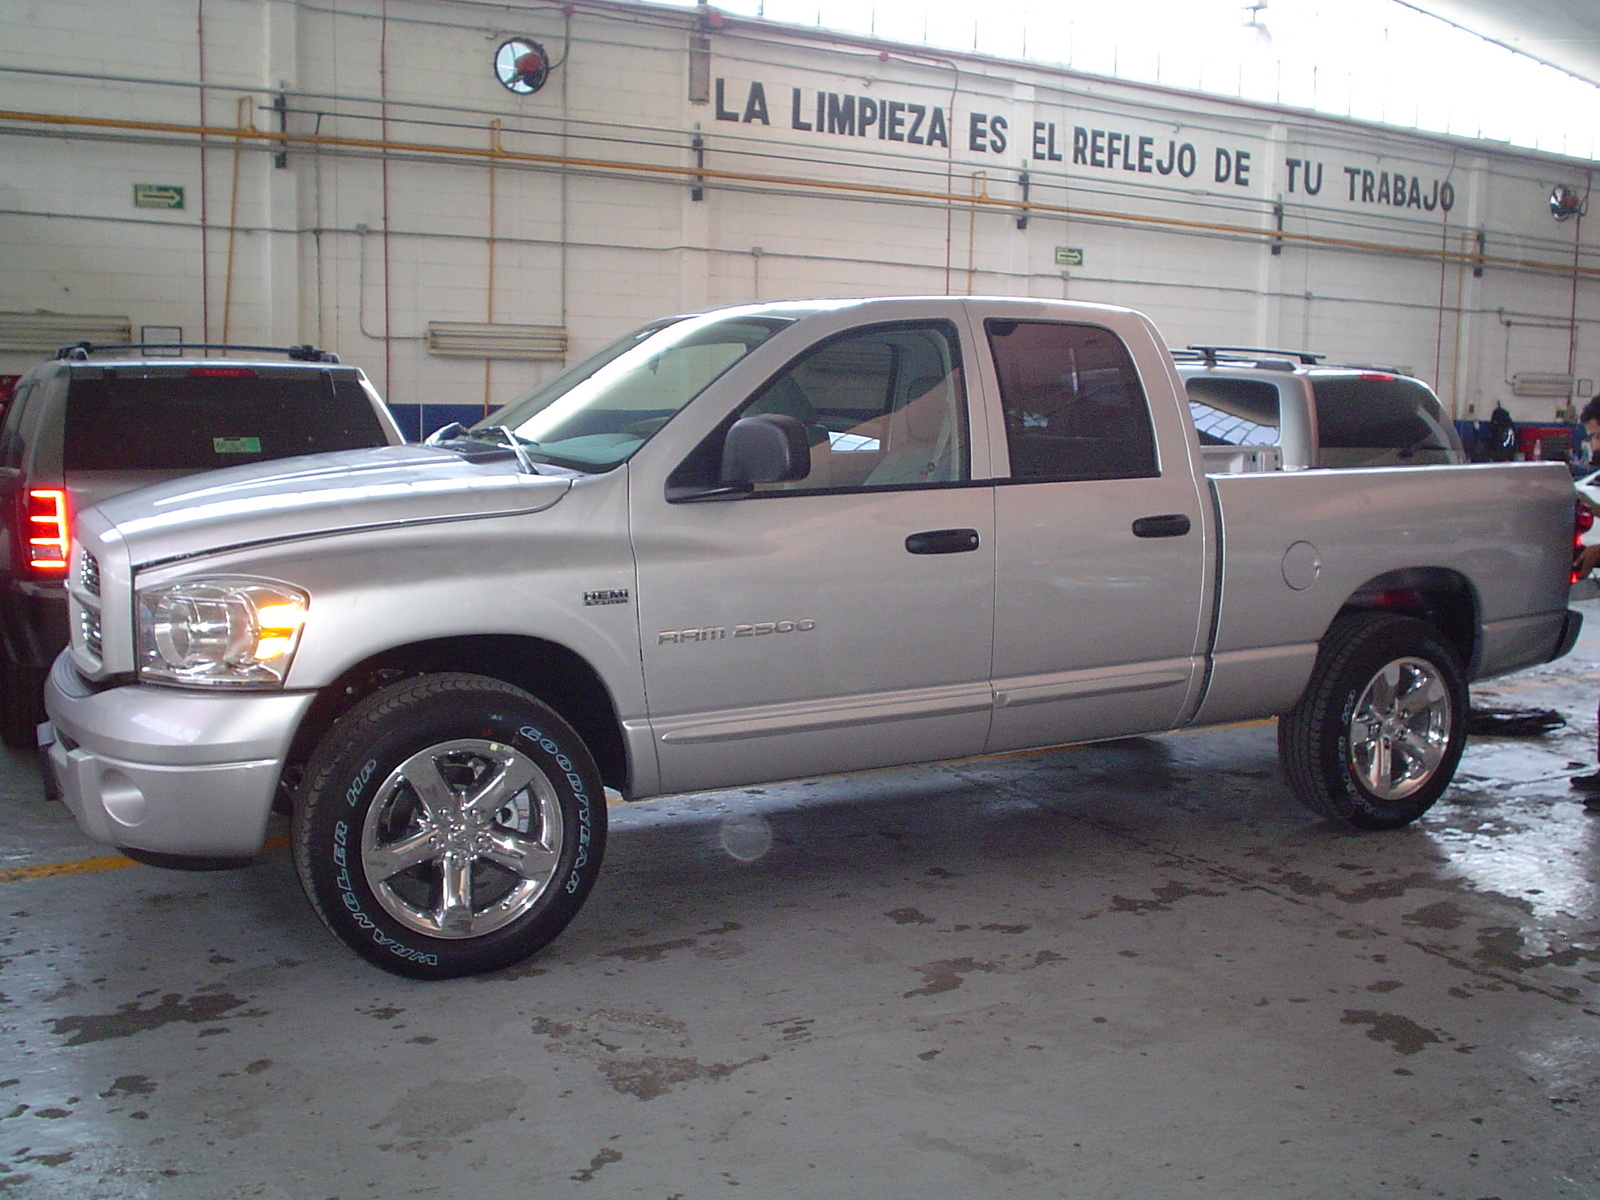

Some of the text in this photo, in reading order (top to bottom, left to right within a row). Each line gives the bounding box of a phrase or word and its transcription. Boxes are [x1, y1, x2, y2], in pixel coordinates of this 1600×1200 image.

[715, 77, 1455, 212] LA LIMPIEZA ES EL REFLEJO DE TU TRABAJO
[583, 590, 629, 601] HEMI
[658, 618, 816, 645] RAM 2500
[333, 758, 438, 966] WRANGLER HP
[519, 725, 591, 894] GOODYEAR
